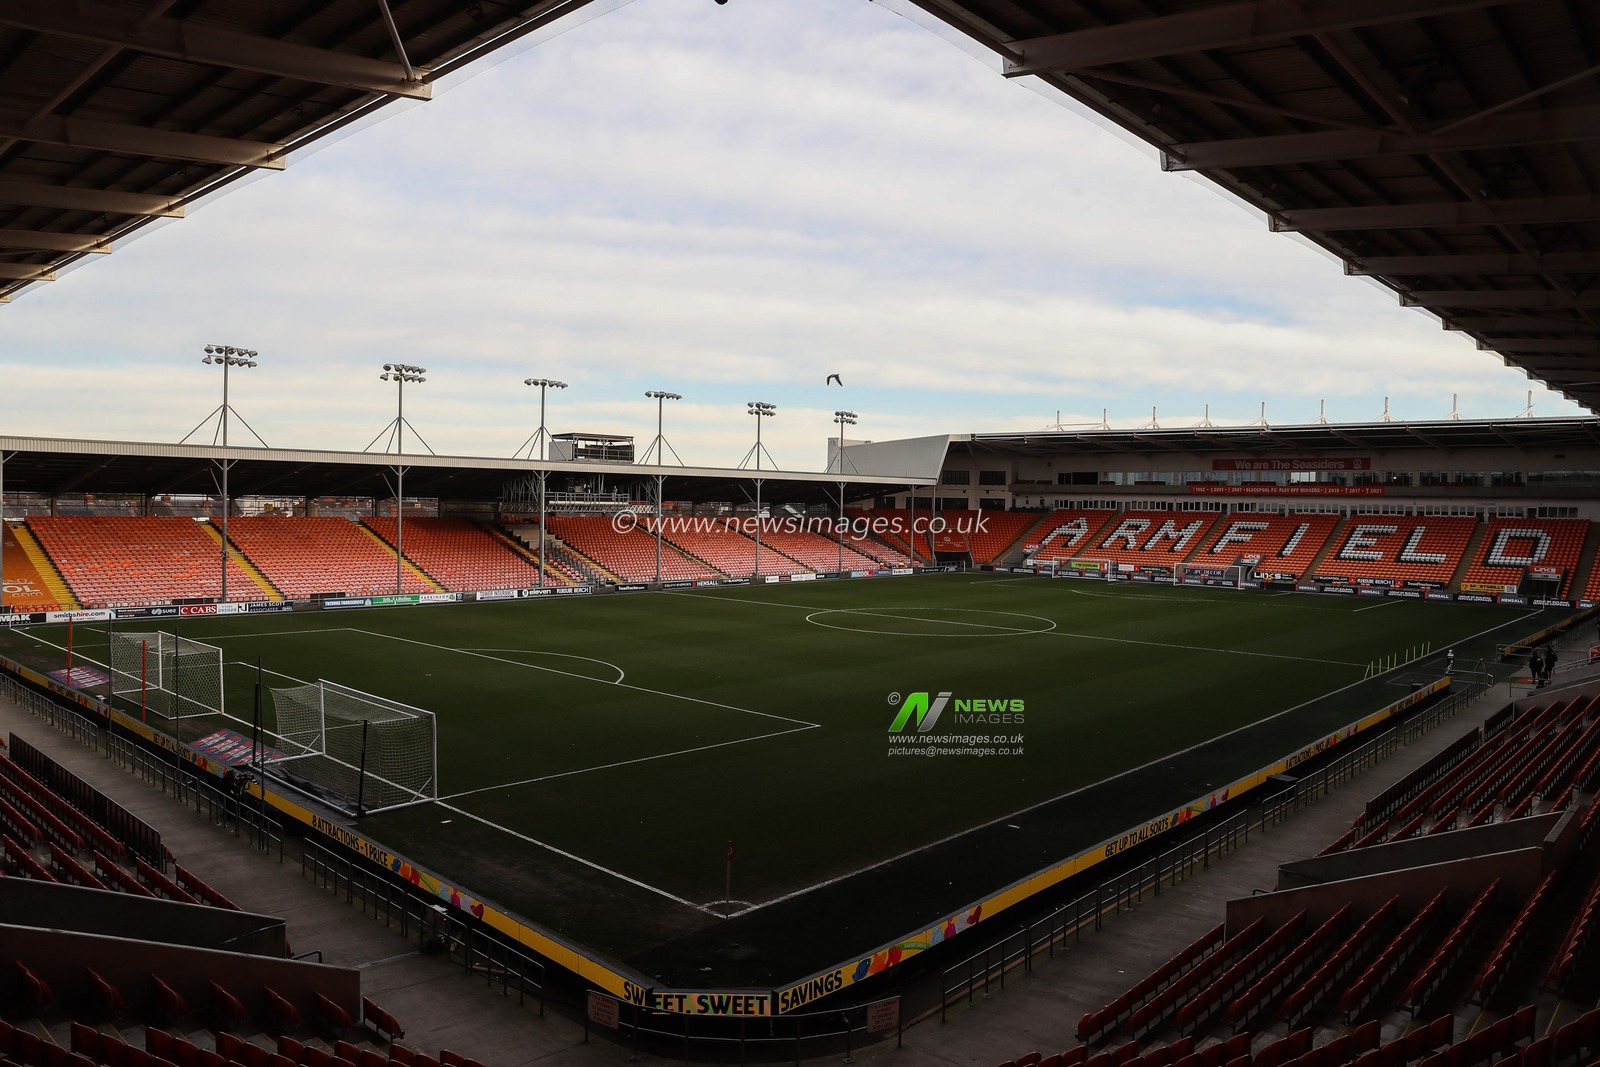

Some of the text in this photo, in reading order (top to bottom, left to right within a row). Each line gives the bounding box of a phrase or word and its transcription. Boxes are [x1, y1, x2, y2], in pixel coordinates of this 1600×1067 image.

[1235, 460, 1345, 470] We are The Seasiders
[1041, 517, 1552, 566] ARMFIELD
[180, 605, 217, 615] C CABS
[312, 815, 317, 827] 8
[317, 817, 360, 852] ATTRACTIONS
[369, 845, 388, 867] PRICE
[1105, 817, 1169, 857] GET UP TO ALL SORTS
[697, 994, 768, 1015] SWEET
[780, 970, 843, 1012] SAVINGS
